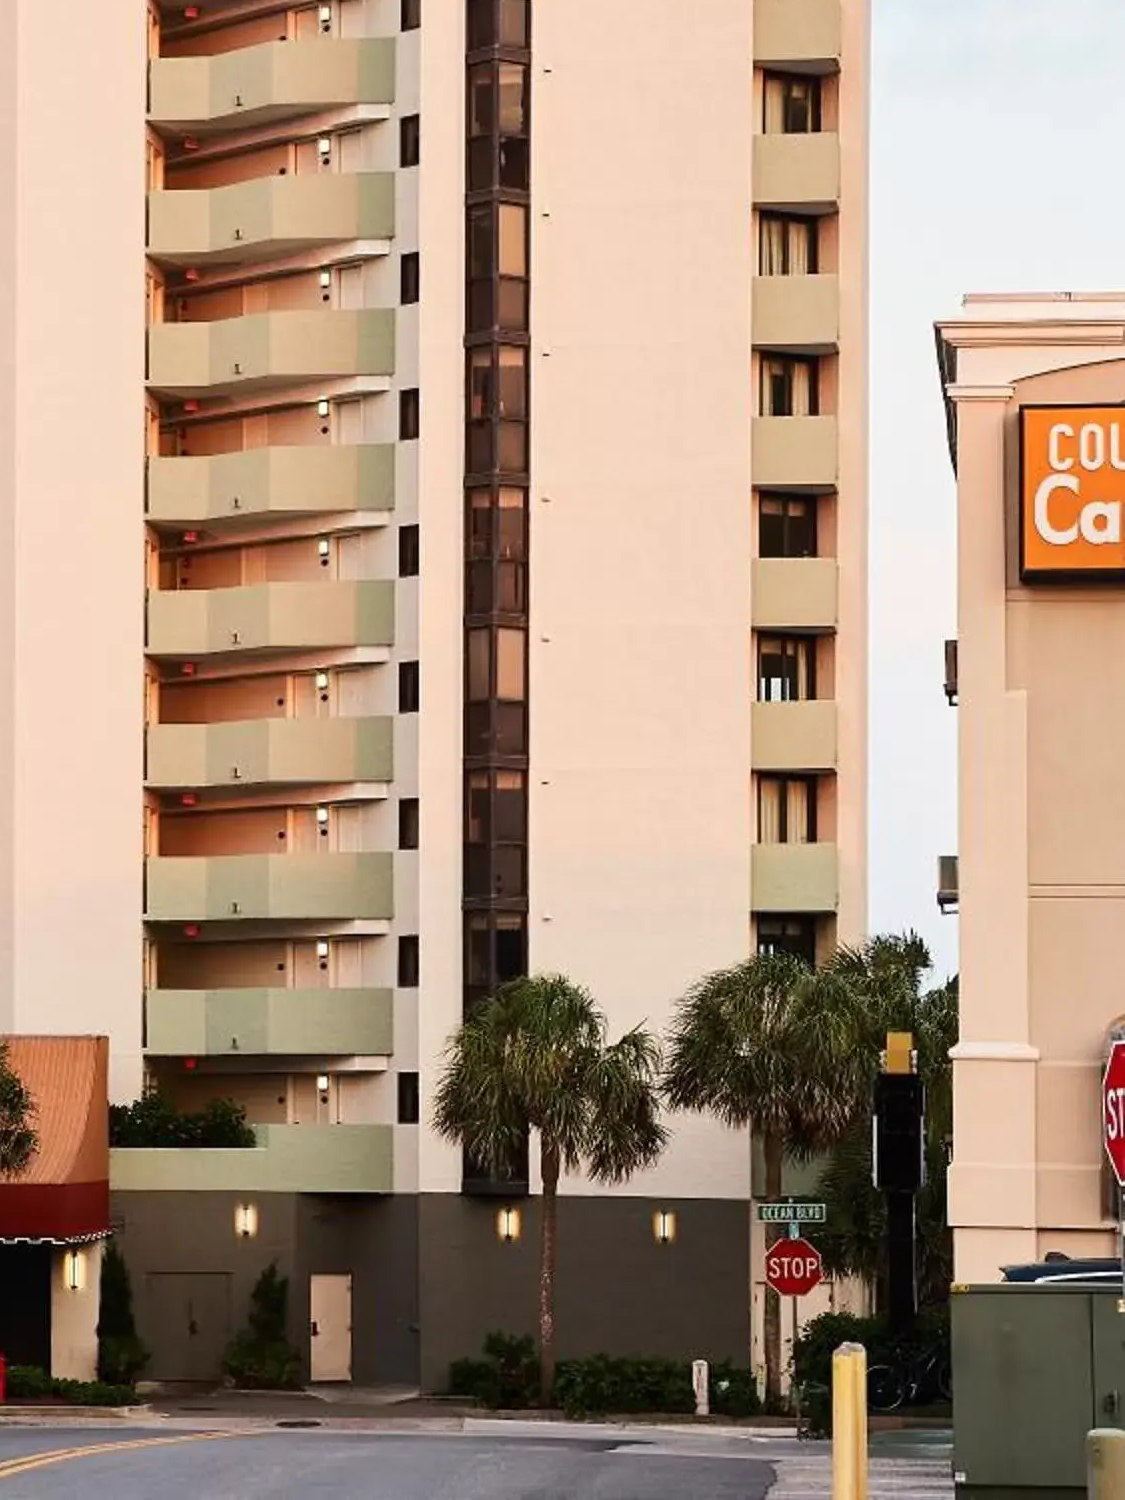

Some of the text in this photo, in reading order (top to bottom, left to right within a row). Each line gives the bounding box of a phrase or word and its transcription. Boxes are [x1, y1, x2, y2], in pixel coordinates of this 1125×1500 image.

[1034, 473, 1121, 545] Ca
[1107, 1088, 1125, 1141] ST
[762, 1207, 822, 1219] OCEAN BLVD
[769, 1257, 818, 1279] STOP
